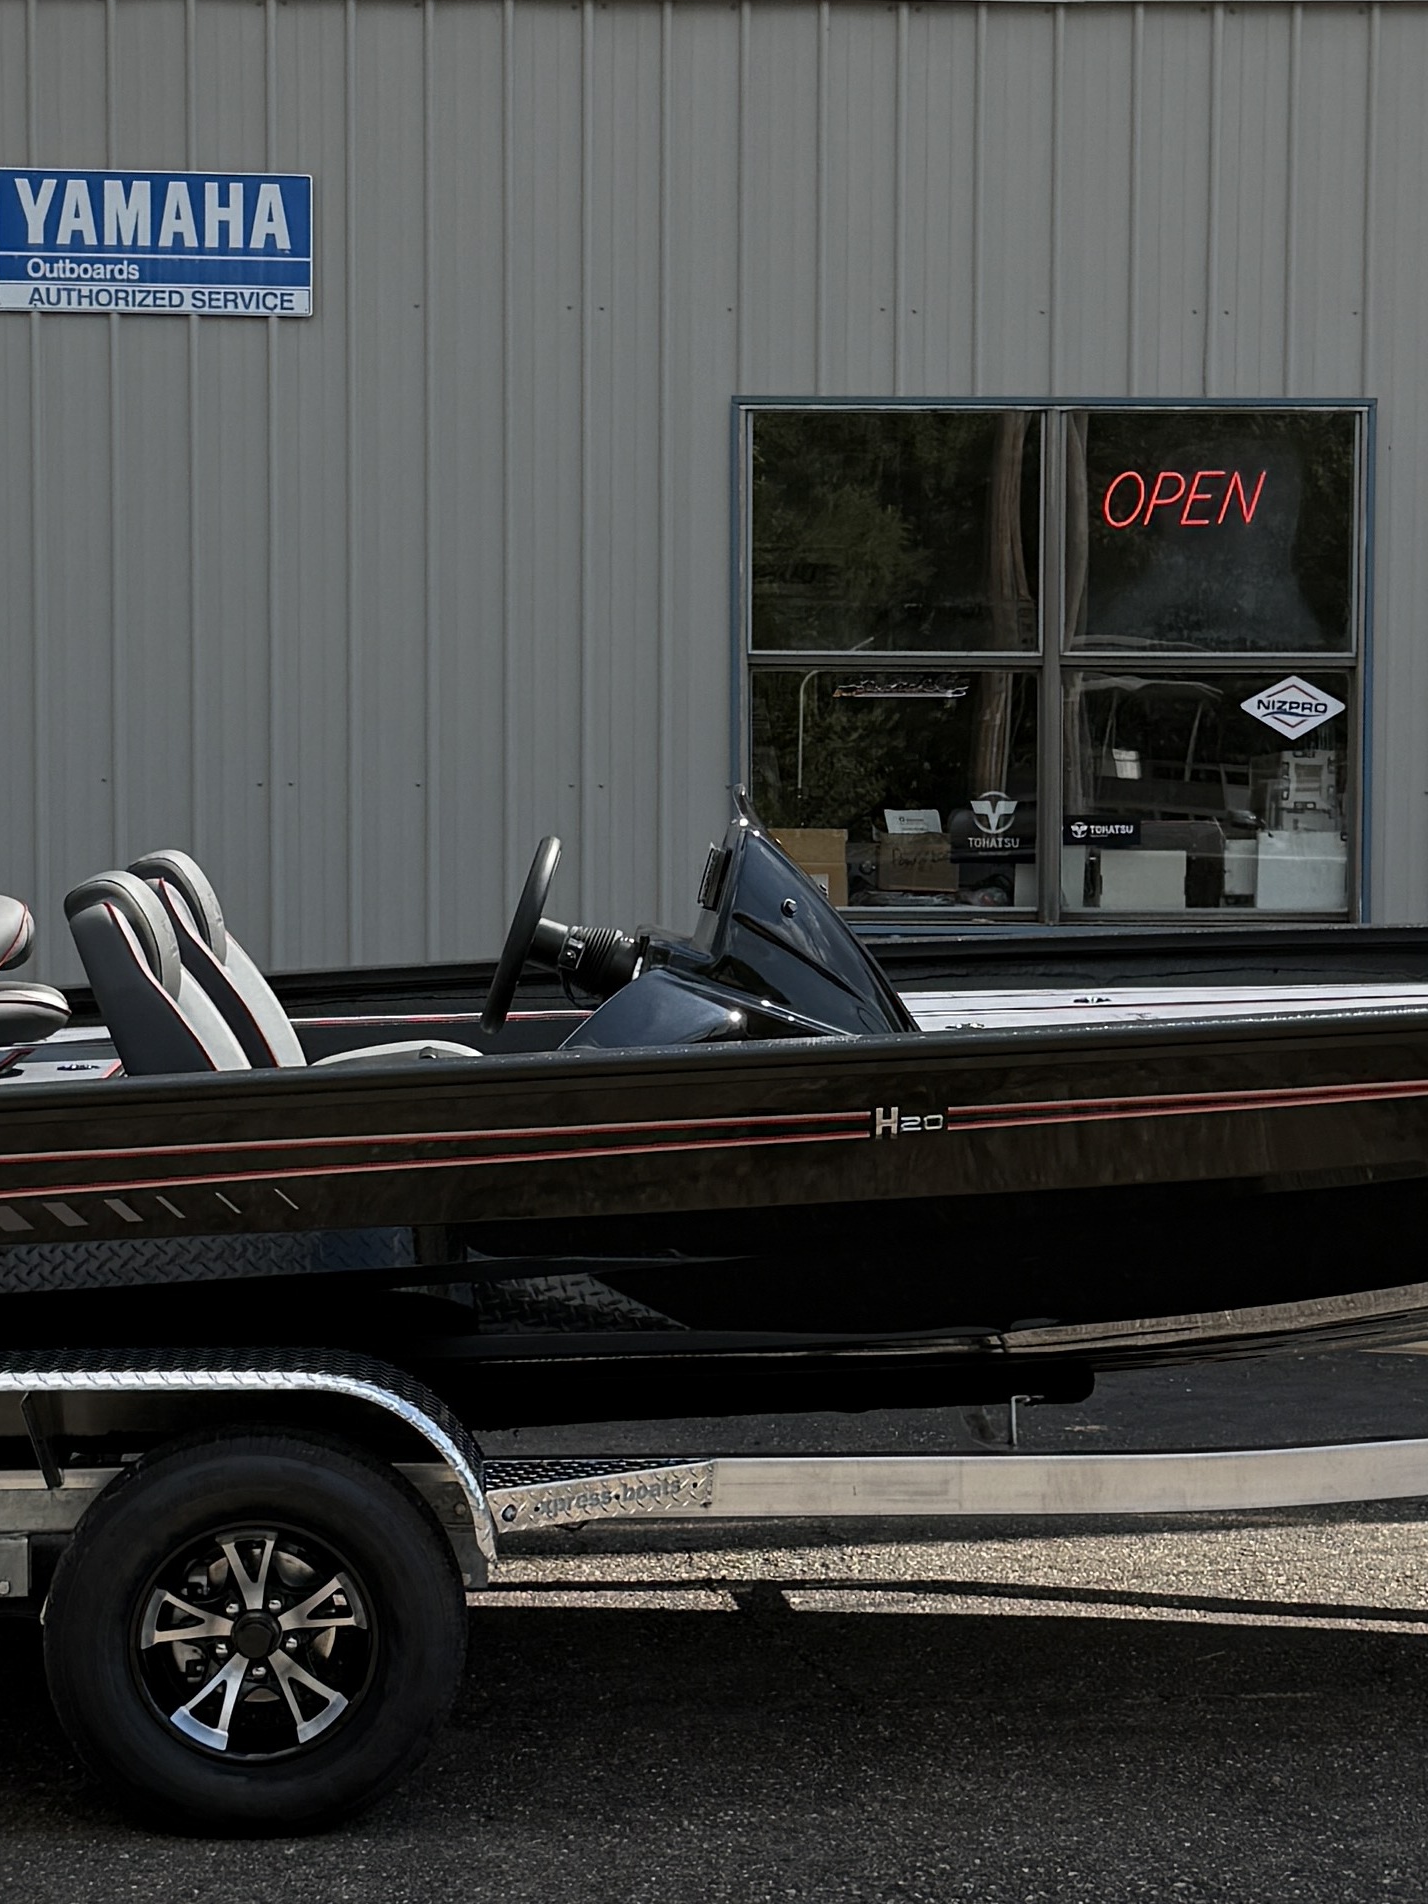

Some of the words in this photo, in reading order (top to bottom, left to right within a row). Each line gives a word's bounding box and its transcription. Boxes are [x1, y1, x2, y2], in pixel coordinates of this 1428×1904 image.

[14, 178, 292, 250] YAMAHA
[26, 258, 140, 280] Outboards
[28, 286, 184, 308] AUTHORIZED
[191, 290, 294, 311] SERVICE
[1103, 470, 1267, 528] OPEN
[1257, 699, 1328, 714] NIZPRO
[1090, 825, 1133, 834] TOHATSU
[967, 837, 1020, 848] TOHATSU
